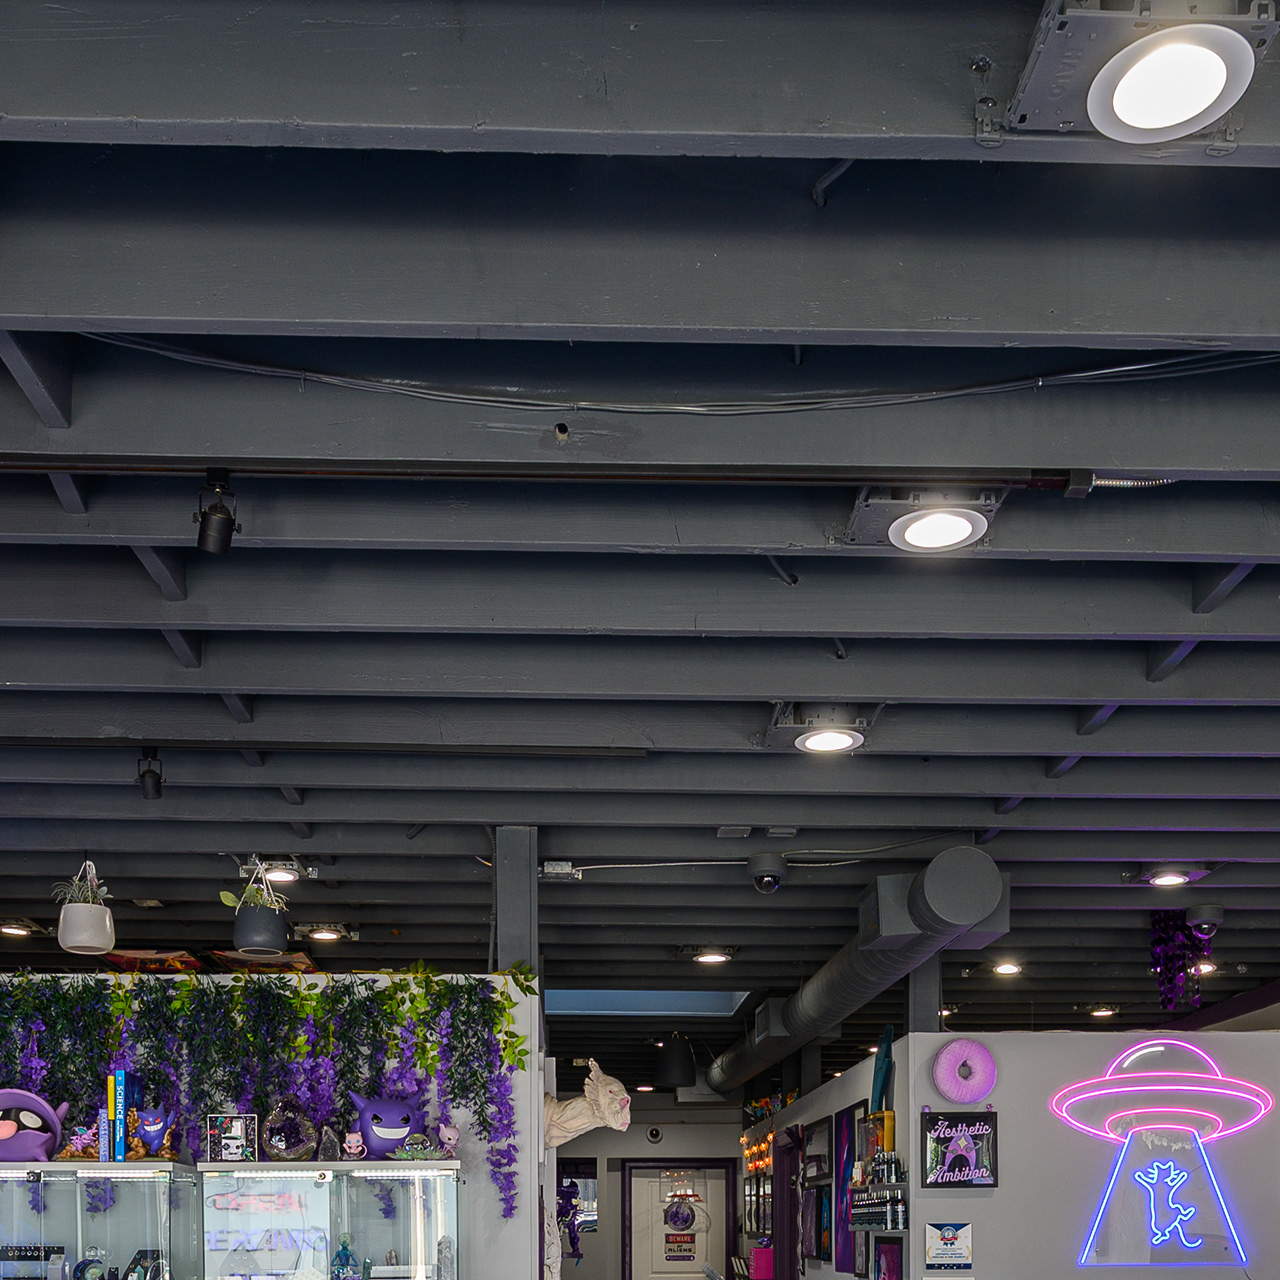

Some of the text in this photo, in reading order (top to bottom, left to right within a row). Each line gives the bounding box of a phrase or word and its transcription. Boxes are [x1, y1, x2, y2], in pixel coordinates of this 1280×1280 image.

[116, 1085, 124, 1119] SCIENCE
[931, 1120, 992, 1138] Aesthetic
[929, 1165, 990, 1183] Ambition
